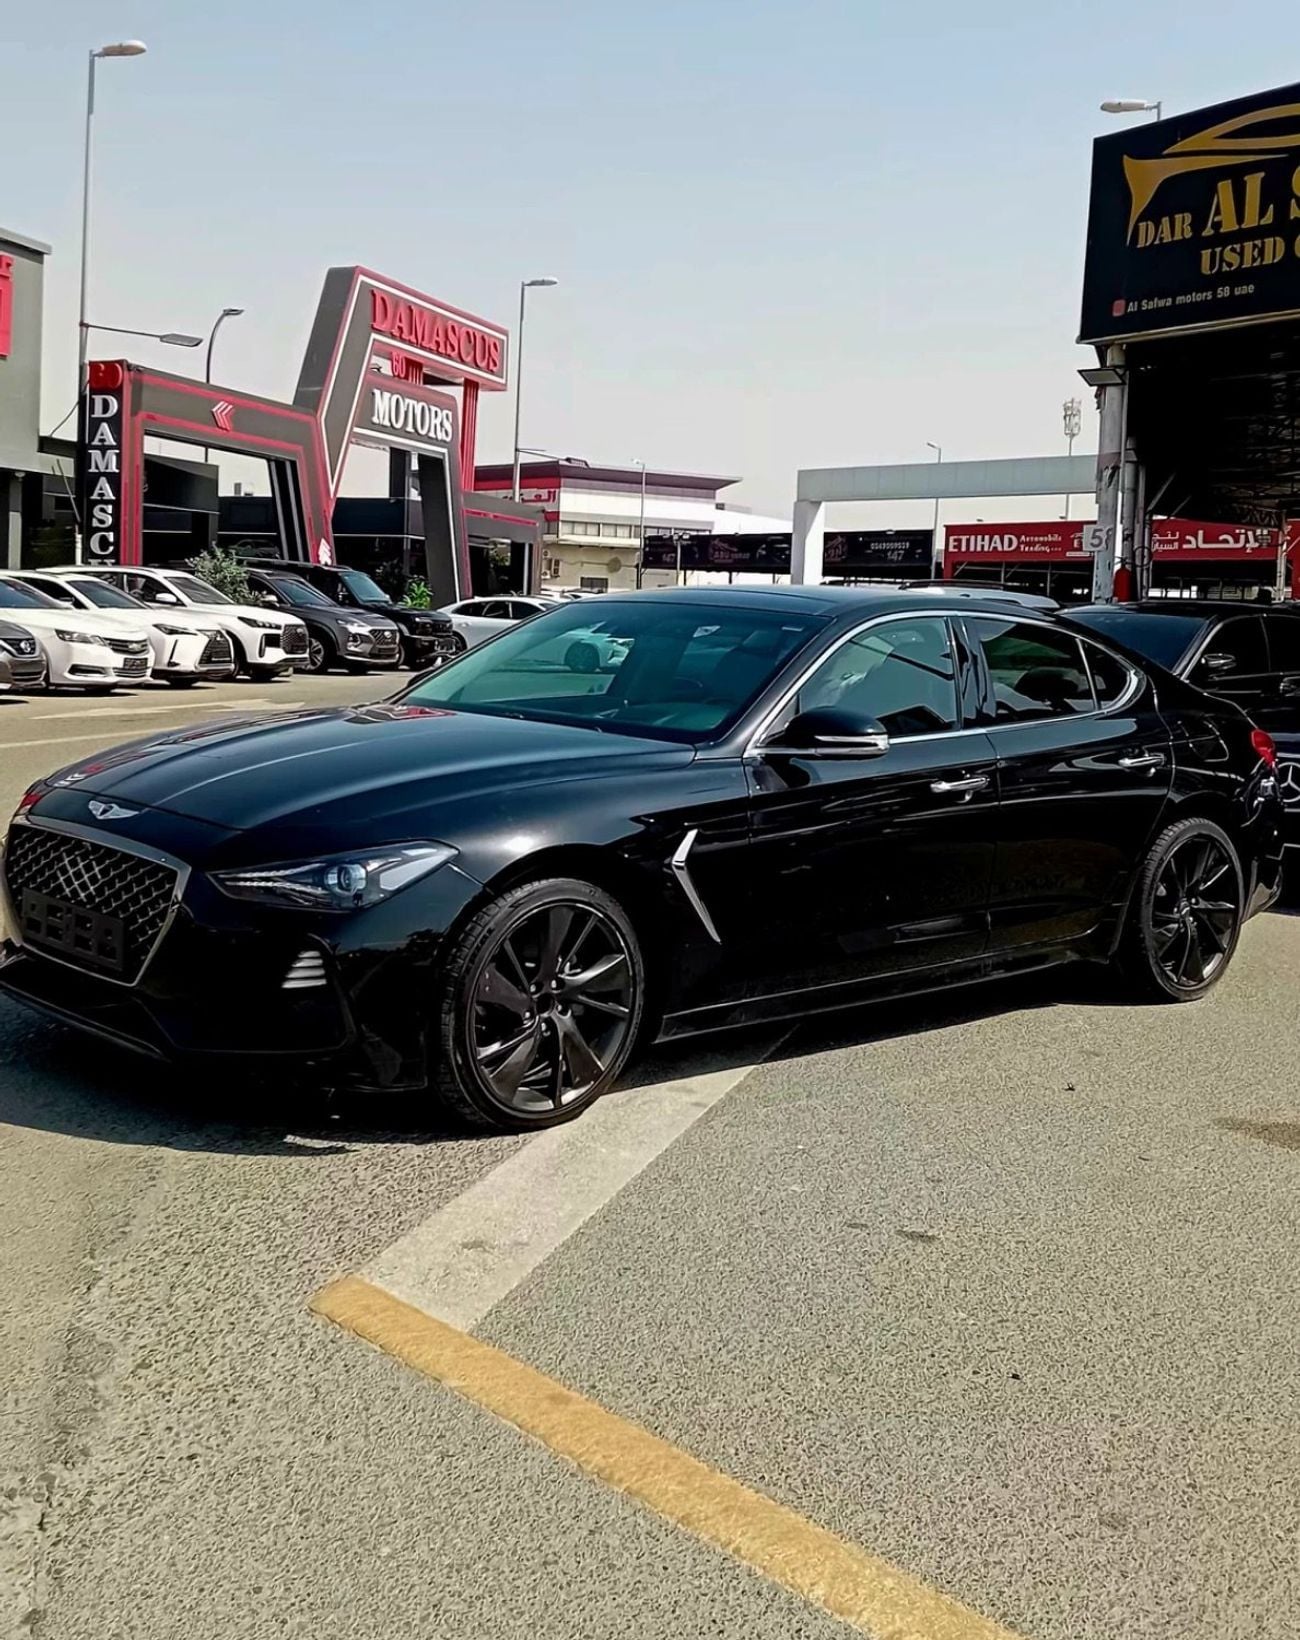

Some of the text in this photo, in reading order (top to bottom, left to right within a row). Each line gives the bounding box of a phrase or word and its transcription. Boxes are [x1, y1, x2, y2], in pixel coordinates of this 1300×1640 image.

[1136, 212, 1193, 248] DAR
[1201, 171, 1275, 236] AL
[1201, 236, 1286, 275] USED
[1127, 284, 1255, 314] Al Safwa motors 58 uae
[370, 289, 500, 373] DAMASCUS
[372, 388, 453, 442] MOTORS
[88, 394, 120, 567] DAMASC
[948, 534, 1019, 552] ETIHAD
